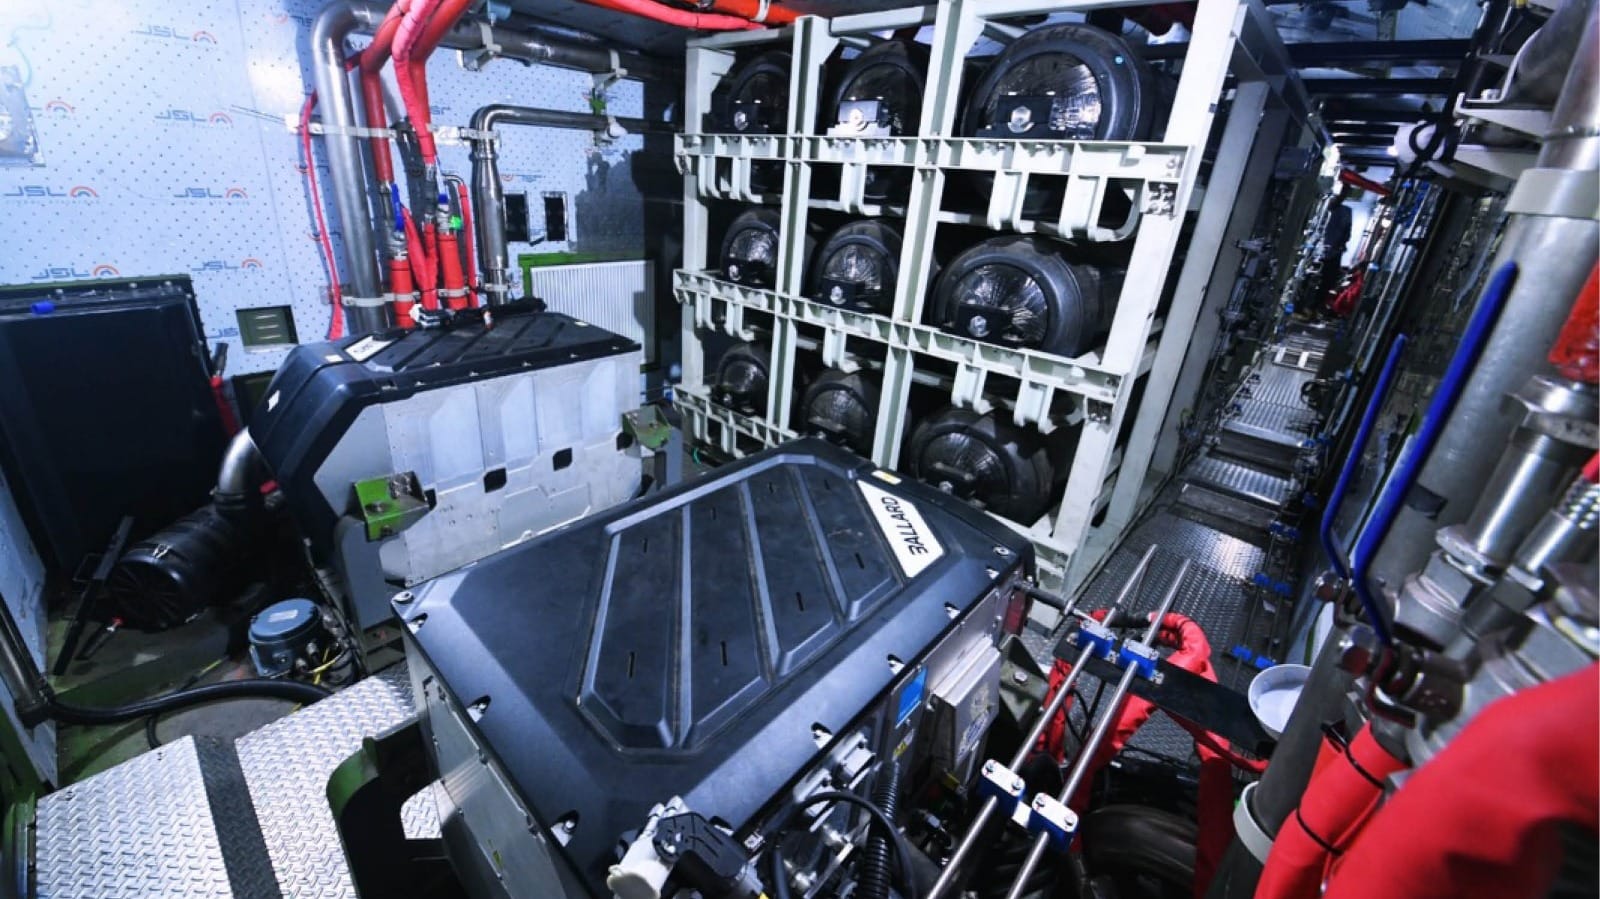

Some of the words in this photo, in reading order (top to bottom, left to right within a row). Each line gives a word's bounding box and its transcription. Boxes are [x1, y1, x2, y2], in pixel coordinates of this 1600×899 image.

[135, 25, 190, 40] JSL
[155, 109, 206, 122] JSL
[430, 106, 451, 115] JS
[4, 185, 67, 197] JSL
[173, 187, 222, 198] JSL
[192, 260, 240, 272] JSL
[31, 267, 90, 279] JSL
[205, 327, 239, 339] JS
[881, 496, 929, 555] BALLARD
